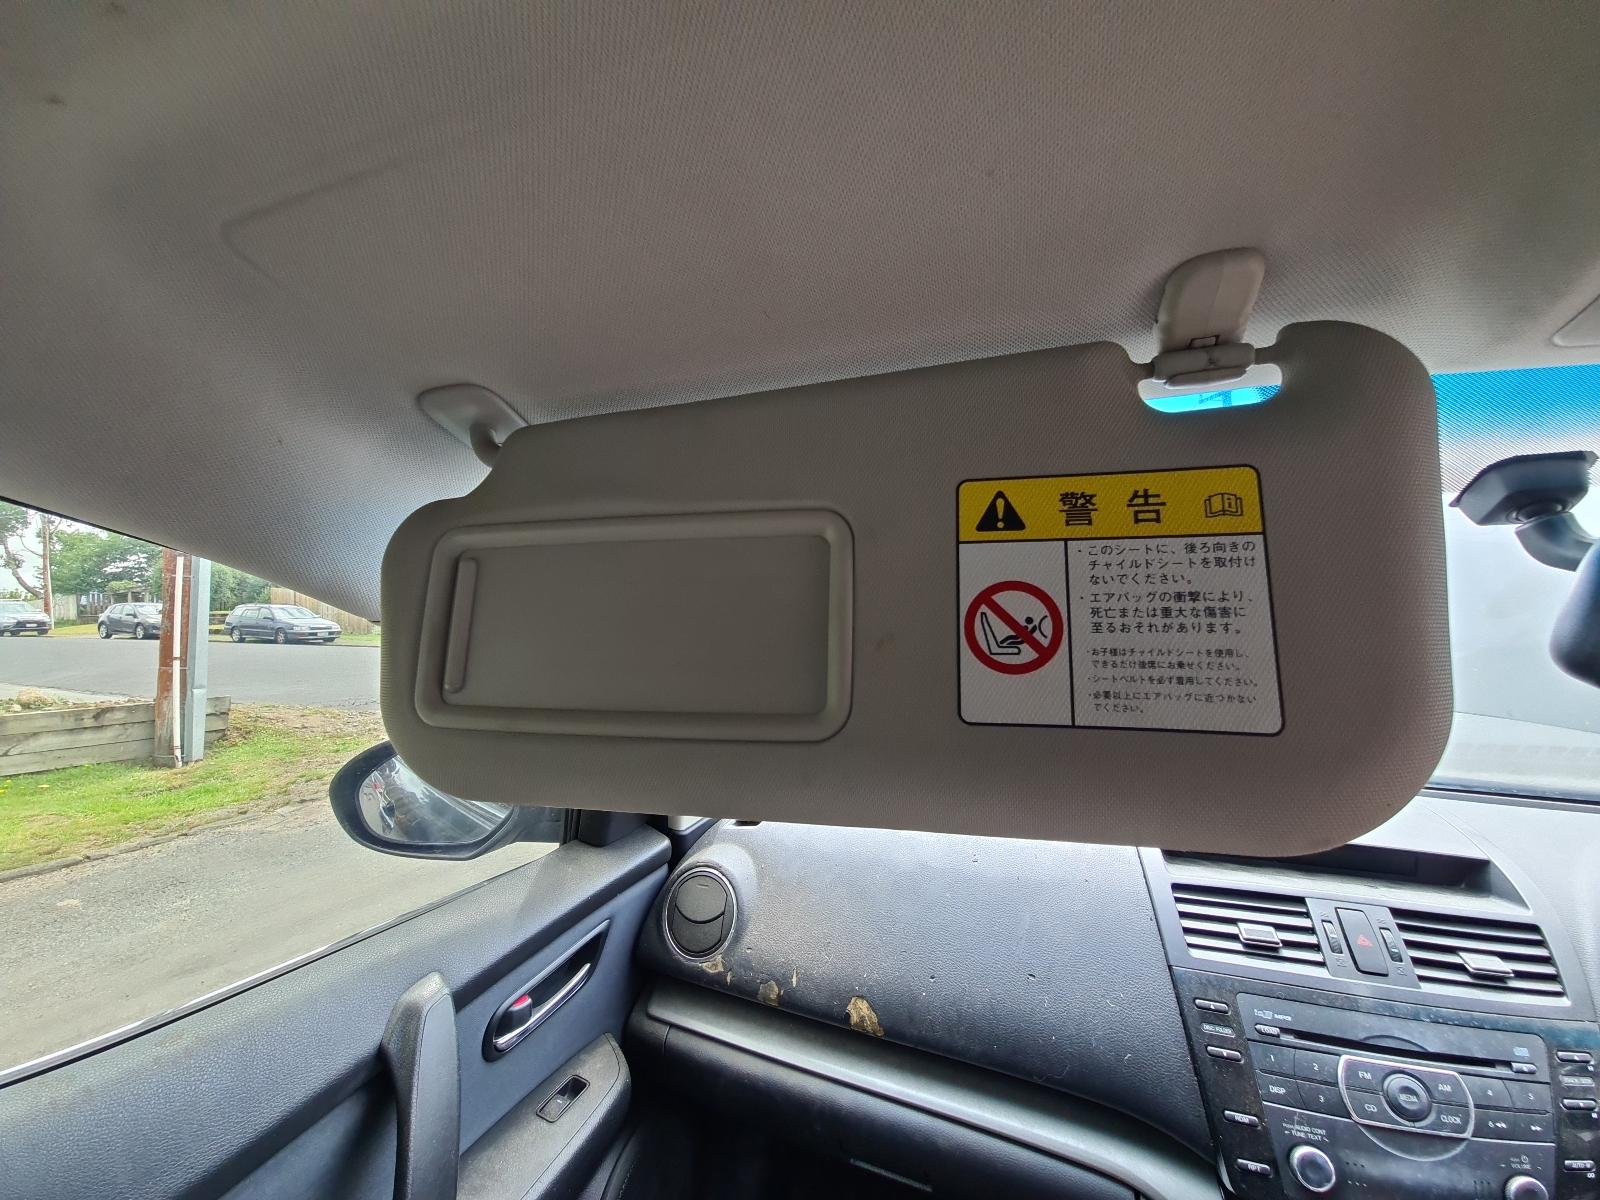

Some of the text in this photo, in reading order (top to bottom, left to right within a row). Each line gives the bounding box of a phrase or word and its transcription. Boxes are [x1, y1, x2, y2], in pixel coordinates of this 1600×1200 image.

[1058, 488, 1167, 527] 警告
[1088, 555, 1256, 571] チャイルドシートを取付け
[1089, 573, 1193, 585] ないでください。
[1090, 606, 1246, 619] 死亡または重大な傷害に
[1091, 622, 1241, 634] 至るおそれがあります。
[1358, 1071, 1372, 1080] FM
[1269, 1085, 1286, 1095] DISP
[1438, 1083, 1452, 1092] AM
[1364, 1104, 1377, 1113] CD
[1440, 1114, 1461, 1124] CLOCK
[1308, 1133, 1322, 1141] TEXT
